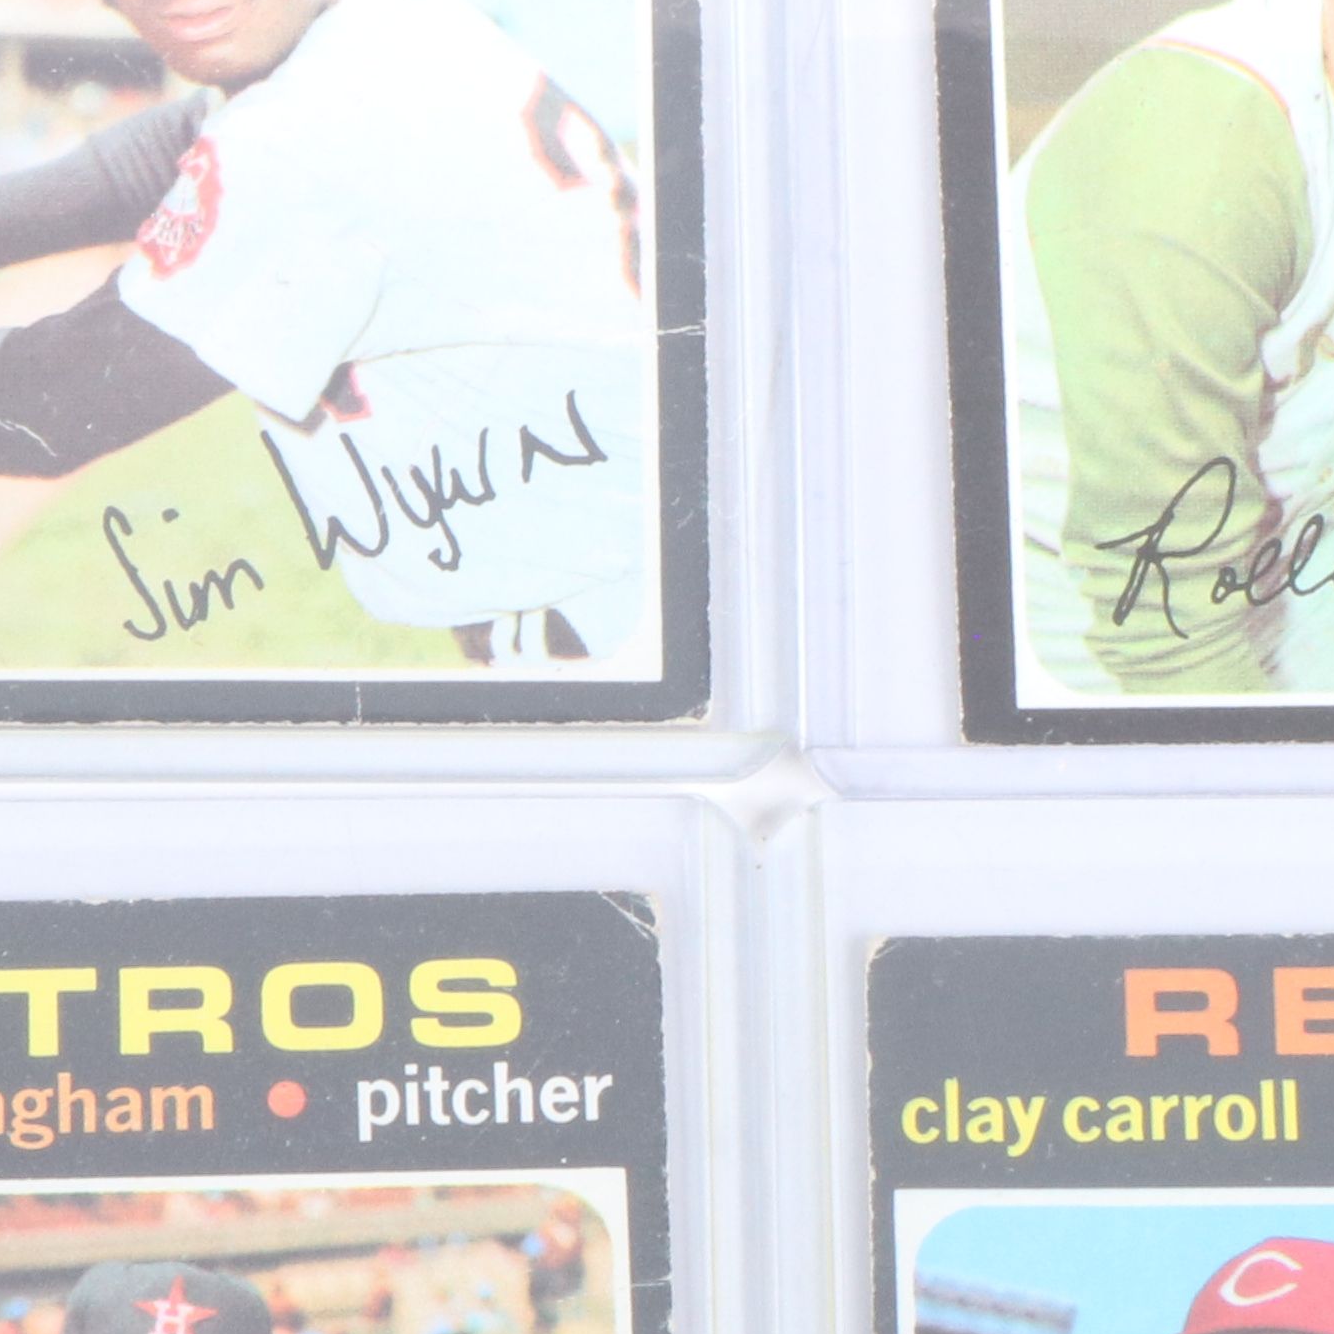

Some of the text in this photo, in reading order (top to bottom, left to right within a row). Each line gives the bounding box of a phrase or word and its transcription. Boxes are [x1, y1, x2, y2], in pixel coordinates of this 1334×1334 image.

[355, 1062, 614, 1143] pitcher
[900, 1078, 1045, 1157] clay
[1064, 1079, 1300, 1144] carroll
[1218, 1249, 1304, 1307] C
